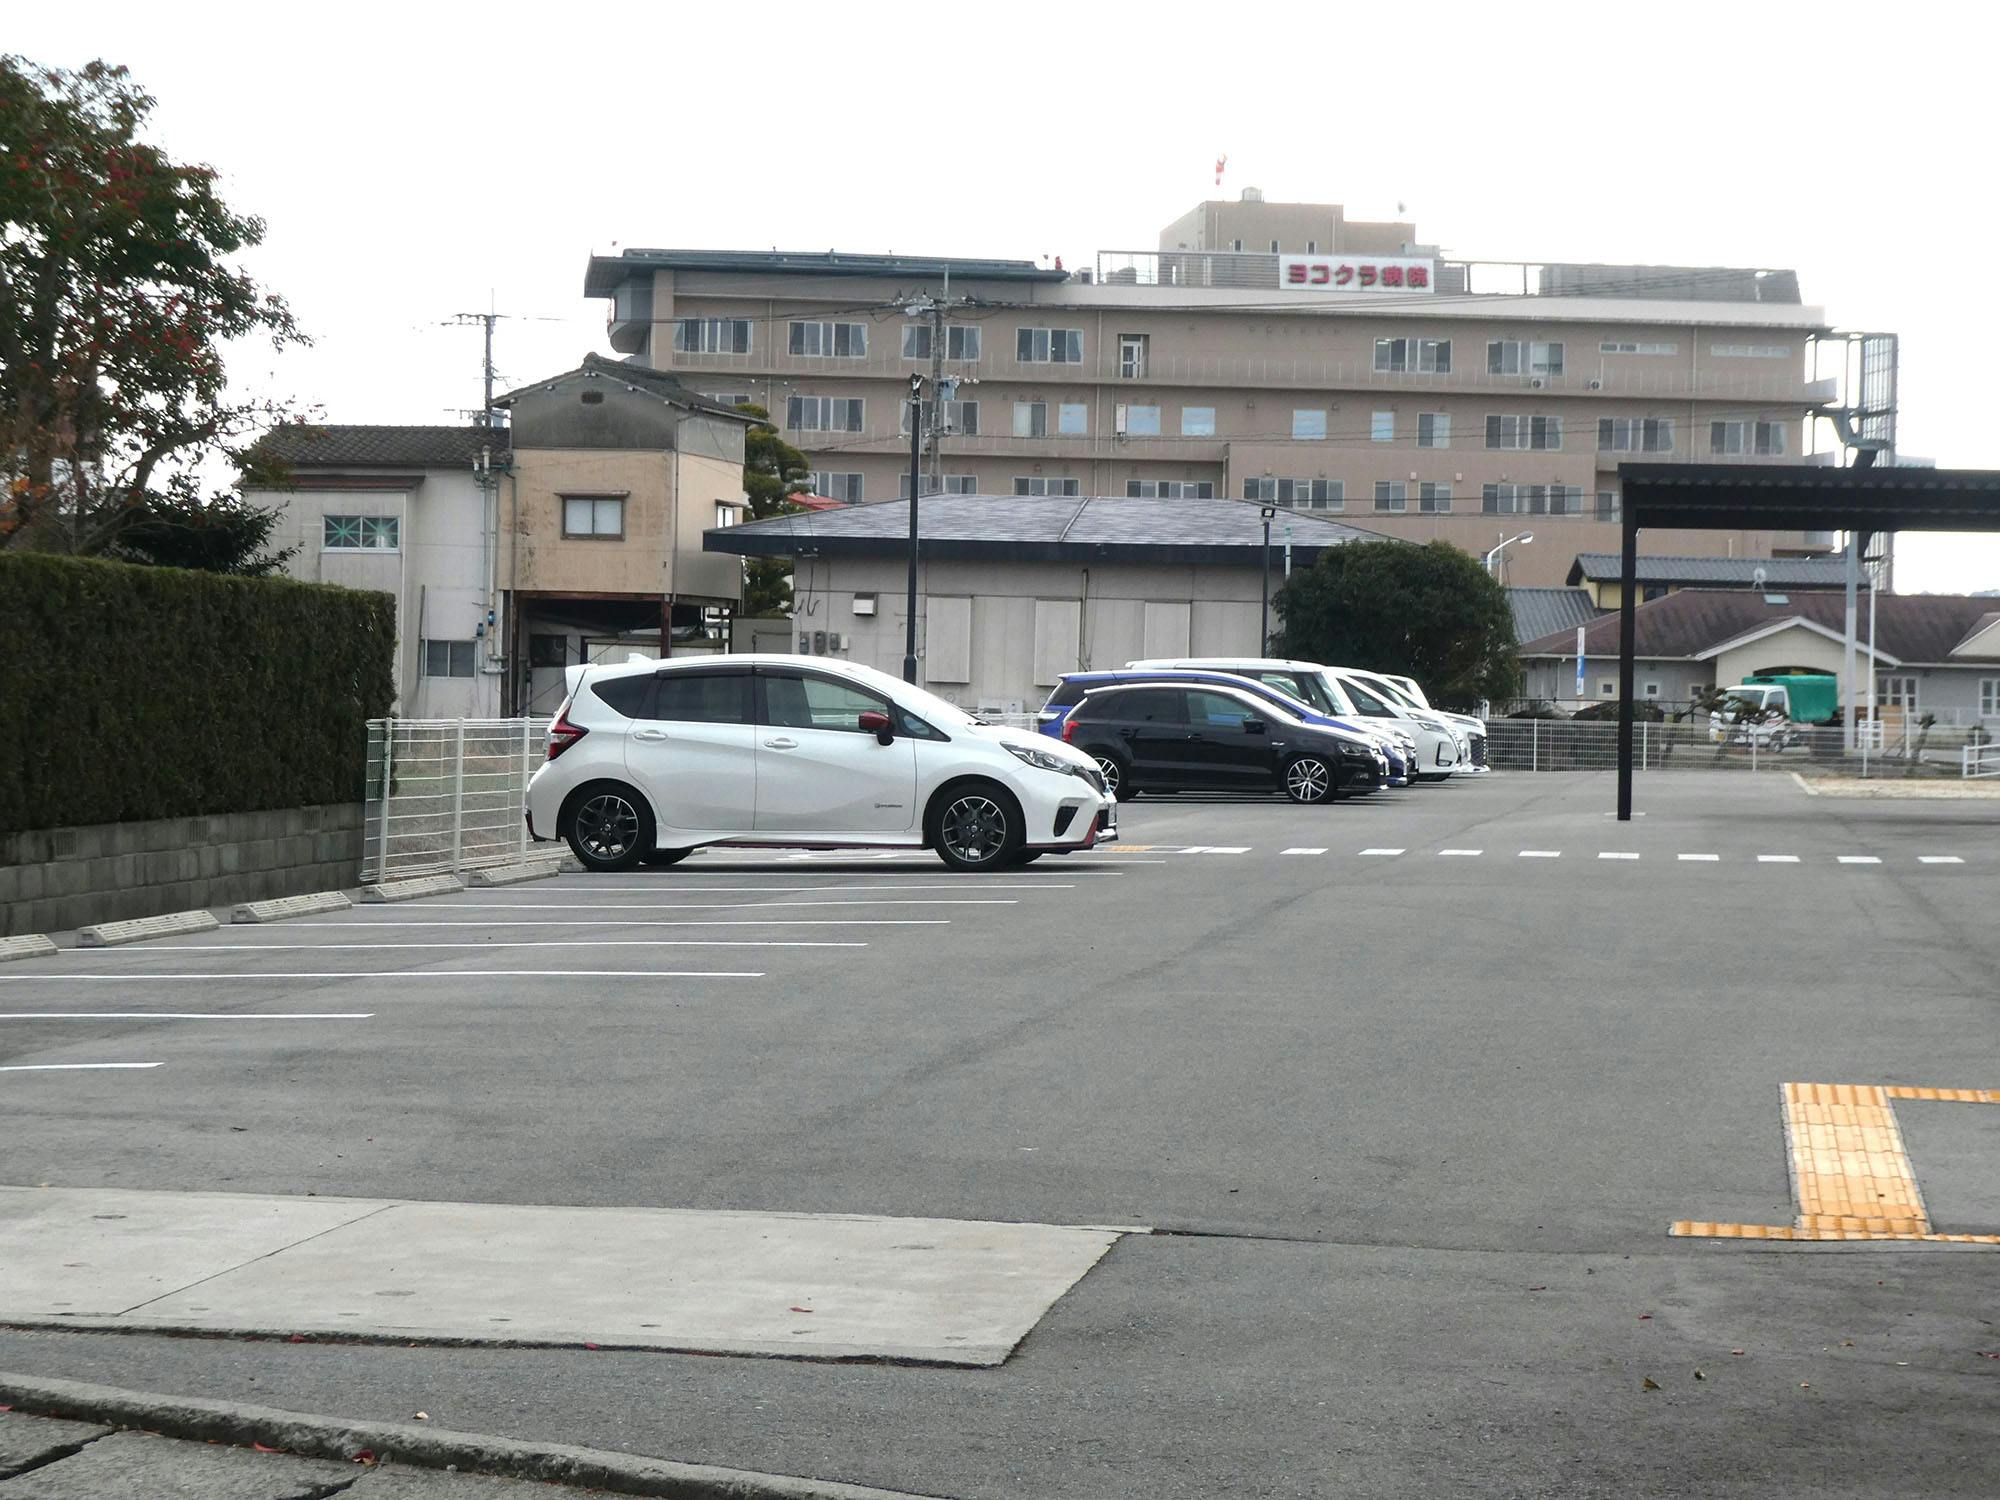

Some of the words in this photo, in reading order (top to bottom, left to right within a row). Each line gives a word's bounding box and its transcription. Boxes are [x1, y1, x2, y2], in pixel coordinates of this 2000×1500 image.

[1288, 264, 1428, 287] ヨコクラ病院
